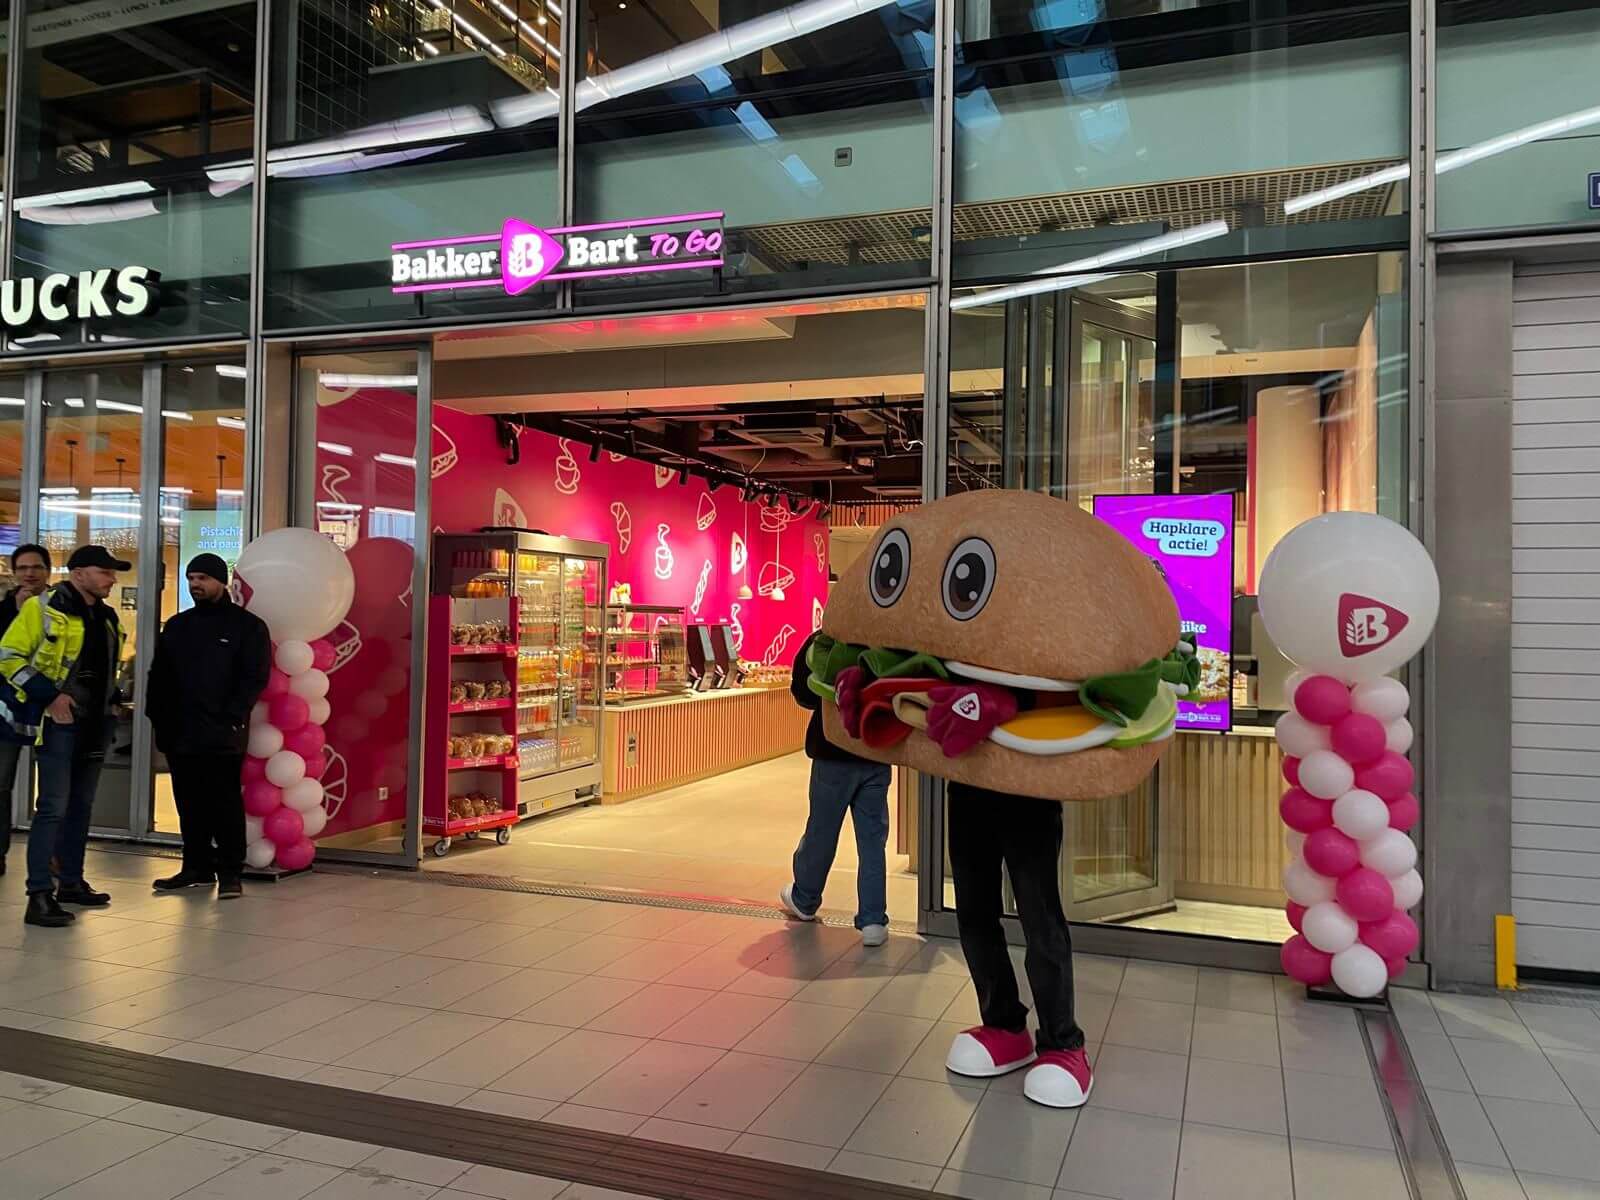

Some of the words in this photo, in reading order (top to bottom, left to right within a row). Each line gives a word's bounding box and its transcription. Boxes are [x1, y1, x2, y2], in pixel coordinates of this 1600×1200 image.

[392, 247, 498, 283] Bakker
[568, 233, 638, 266] Bart
[1, 266, 149, 326] UCKS
[1150, 521, 1217, 536] Hapklare
[198, 540, 217, 549] and
[1168, 538, 1208, 551] actie!
